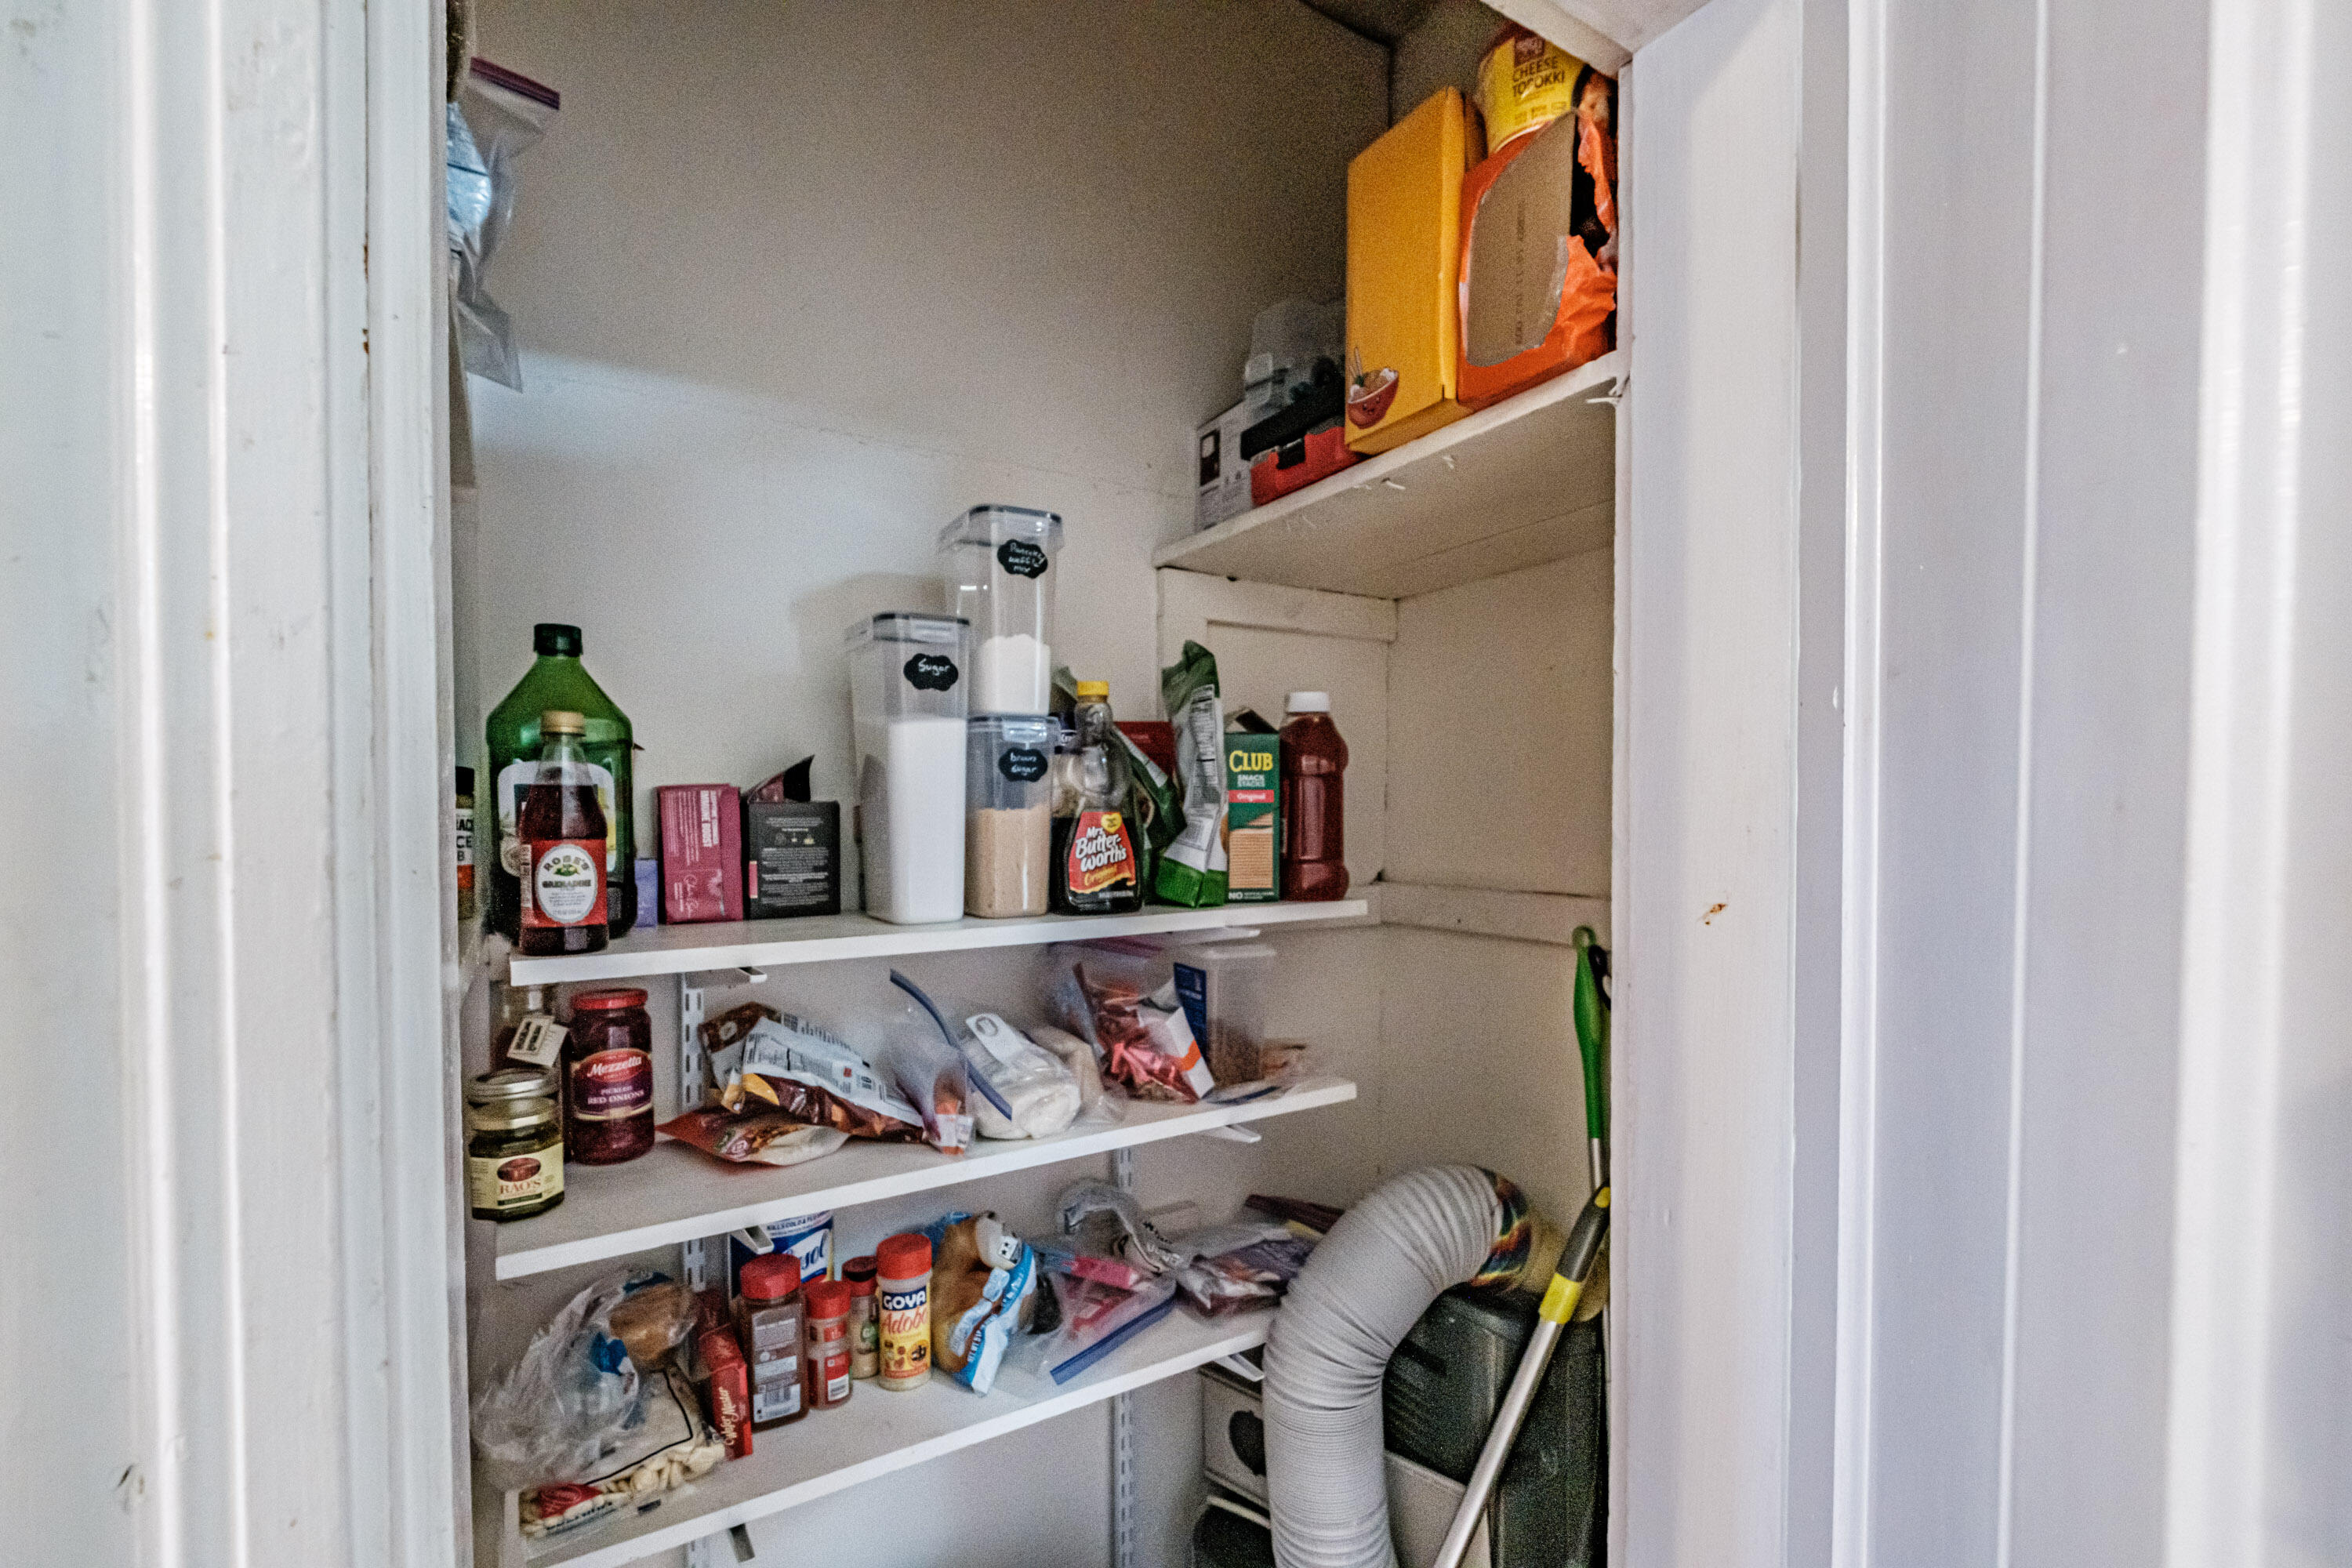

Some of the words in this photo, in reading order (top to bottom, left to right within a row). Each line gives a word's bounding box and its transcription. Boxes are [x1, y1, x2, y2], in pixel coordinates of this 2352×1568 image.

[1512, 56, 1558, 82] CHEESE
[918, 658, 950, 677] Sugar
[1010, 752, 1036, 762] brown
[1229, 750, 1273, 772] CLUB
[1236, 793, 1266, 803] Original
[1076, 833, 1122, 859] Butter-
[1080, 844, 1127, 873] worth's
[1228, 891, 1243, 900] NO
[586, 1056, 642, 1077] Mezzetta
[608, 1090, 644, 1103] ONIONS
[883, 1290, 927, 1310] GOYA
